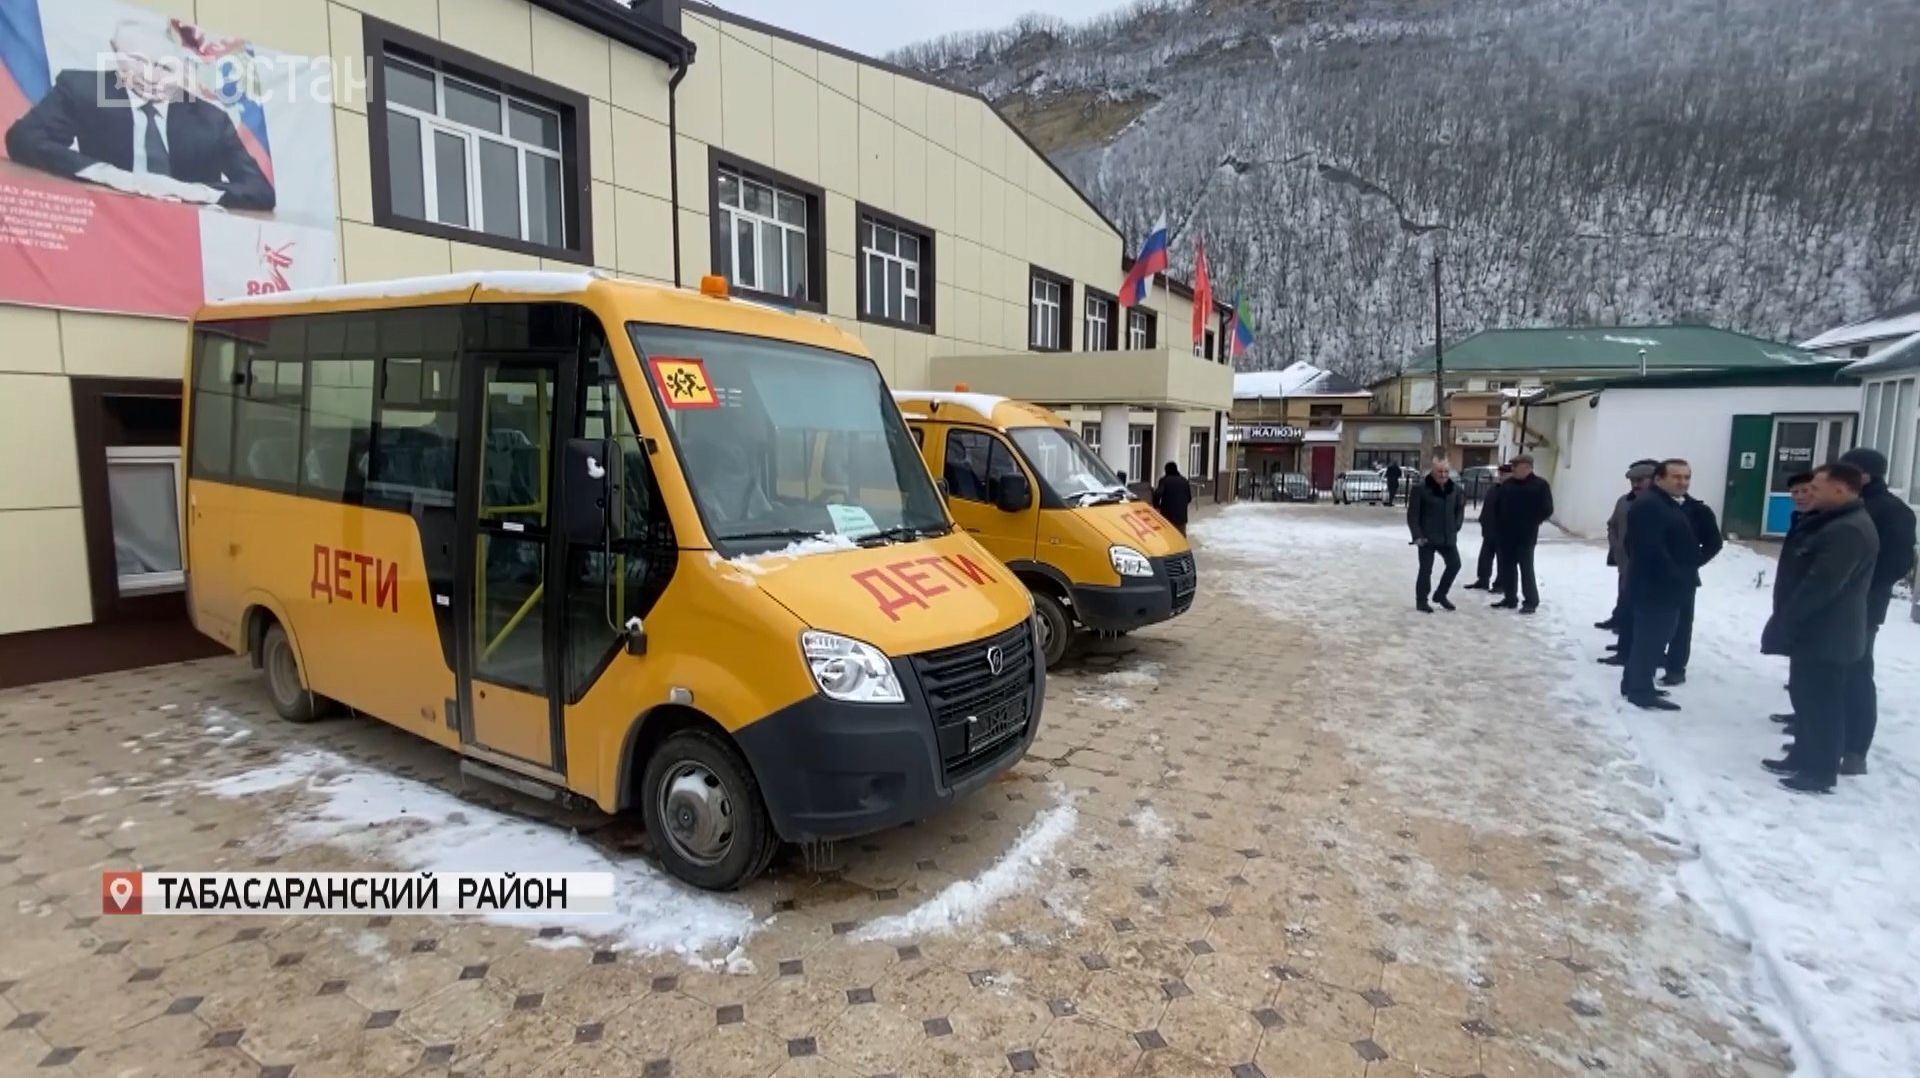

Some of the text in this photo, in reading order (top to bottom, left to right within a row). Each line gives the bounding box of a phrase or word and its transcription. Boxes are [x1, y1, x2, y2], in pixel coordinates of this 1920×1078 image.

[1251, 427, 1303, 438] ЖАЛЮЗИ
[311, 544, 399, 613] ДЕТИ
[851, 553, 998, 622] ДЕТИ
